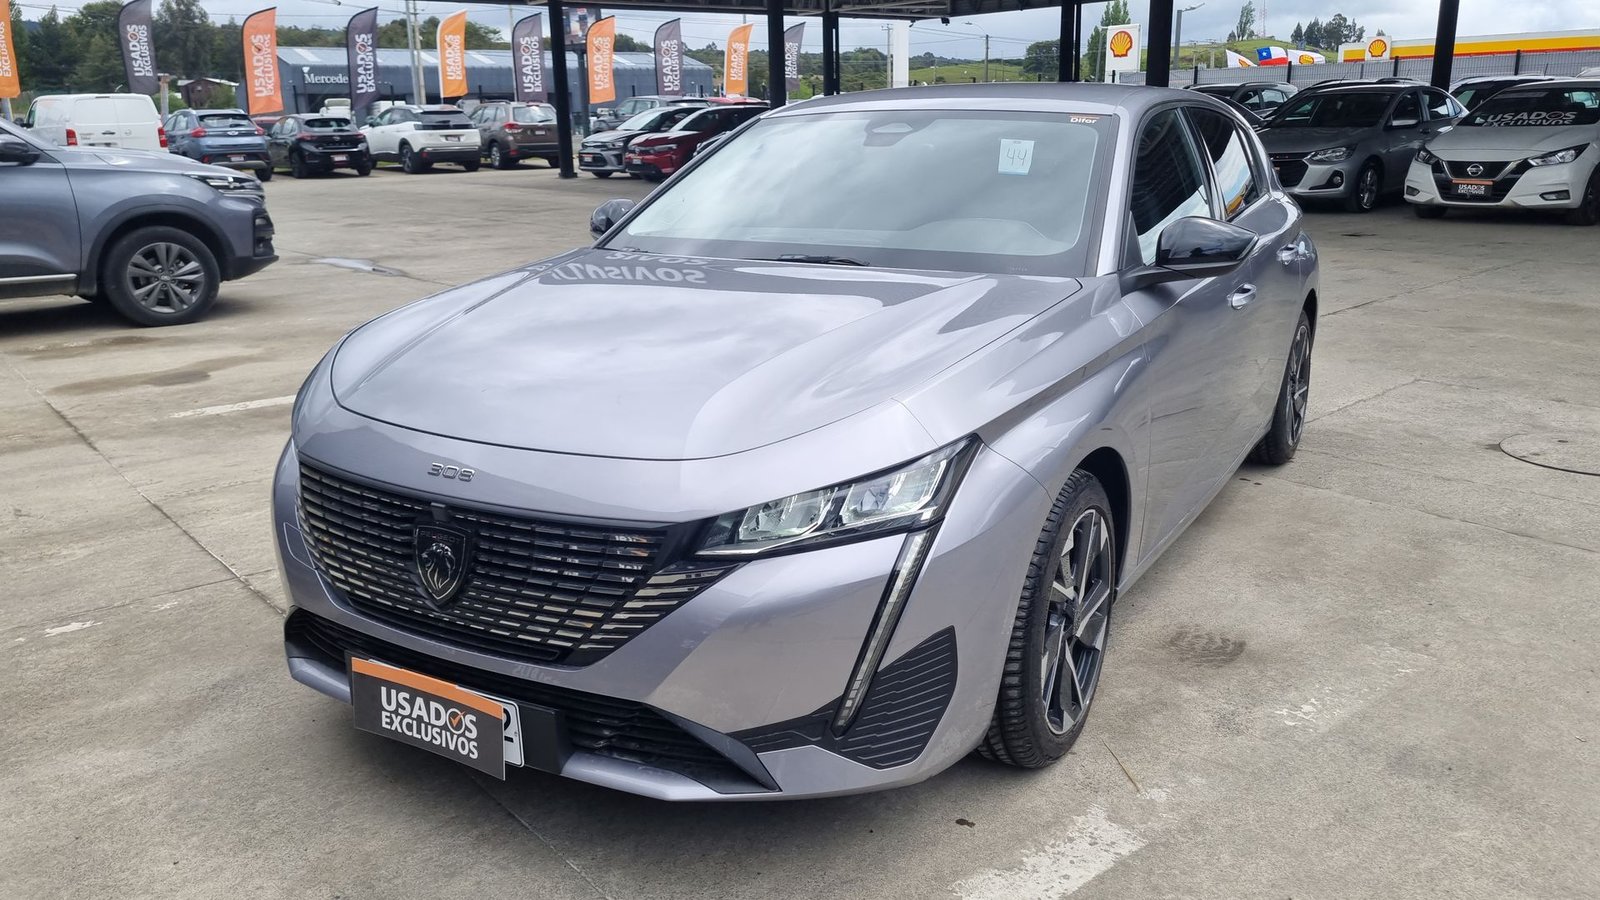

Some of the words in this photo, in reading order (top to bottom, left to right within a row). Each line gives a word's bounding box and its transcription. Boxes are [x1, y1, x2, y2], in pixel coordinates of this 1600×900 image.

[127, 24, 146, 76] USADOS
[139, 25, 154, 77] EXCLUSIVOS
[251, 34, 266, 97] USADOS
[262, 34, 275, 96] EXCLUSIVOS
[355, 34, 368, 94] USADOS
[366, 33, 376, 93] EXCLUSIVOS
[444, 35, 455, 80] USADOS
[520, 37, 534, 92] USADOS
[530, 36, 542, 92] EXCLUSIVOS
[593, 37, 605, 90] USADOS
[661, 40, 674, 91] USADOS
[670, 39, 681, 91] EXCLUSIVOS
[731, 42, 741, 80] USADOS
[785, 42, 794, 78] USADOS
[1486, 111, 1578, 121] USADOS
[1006, 147, 1028, 166] 44
[427, 462, 476, 482] 308
[381, 686, 478, 740] USADOS
[381, 710, 480, 760] EXCLUSIVOS
